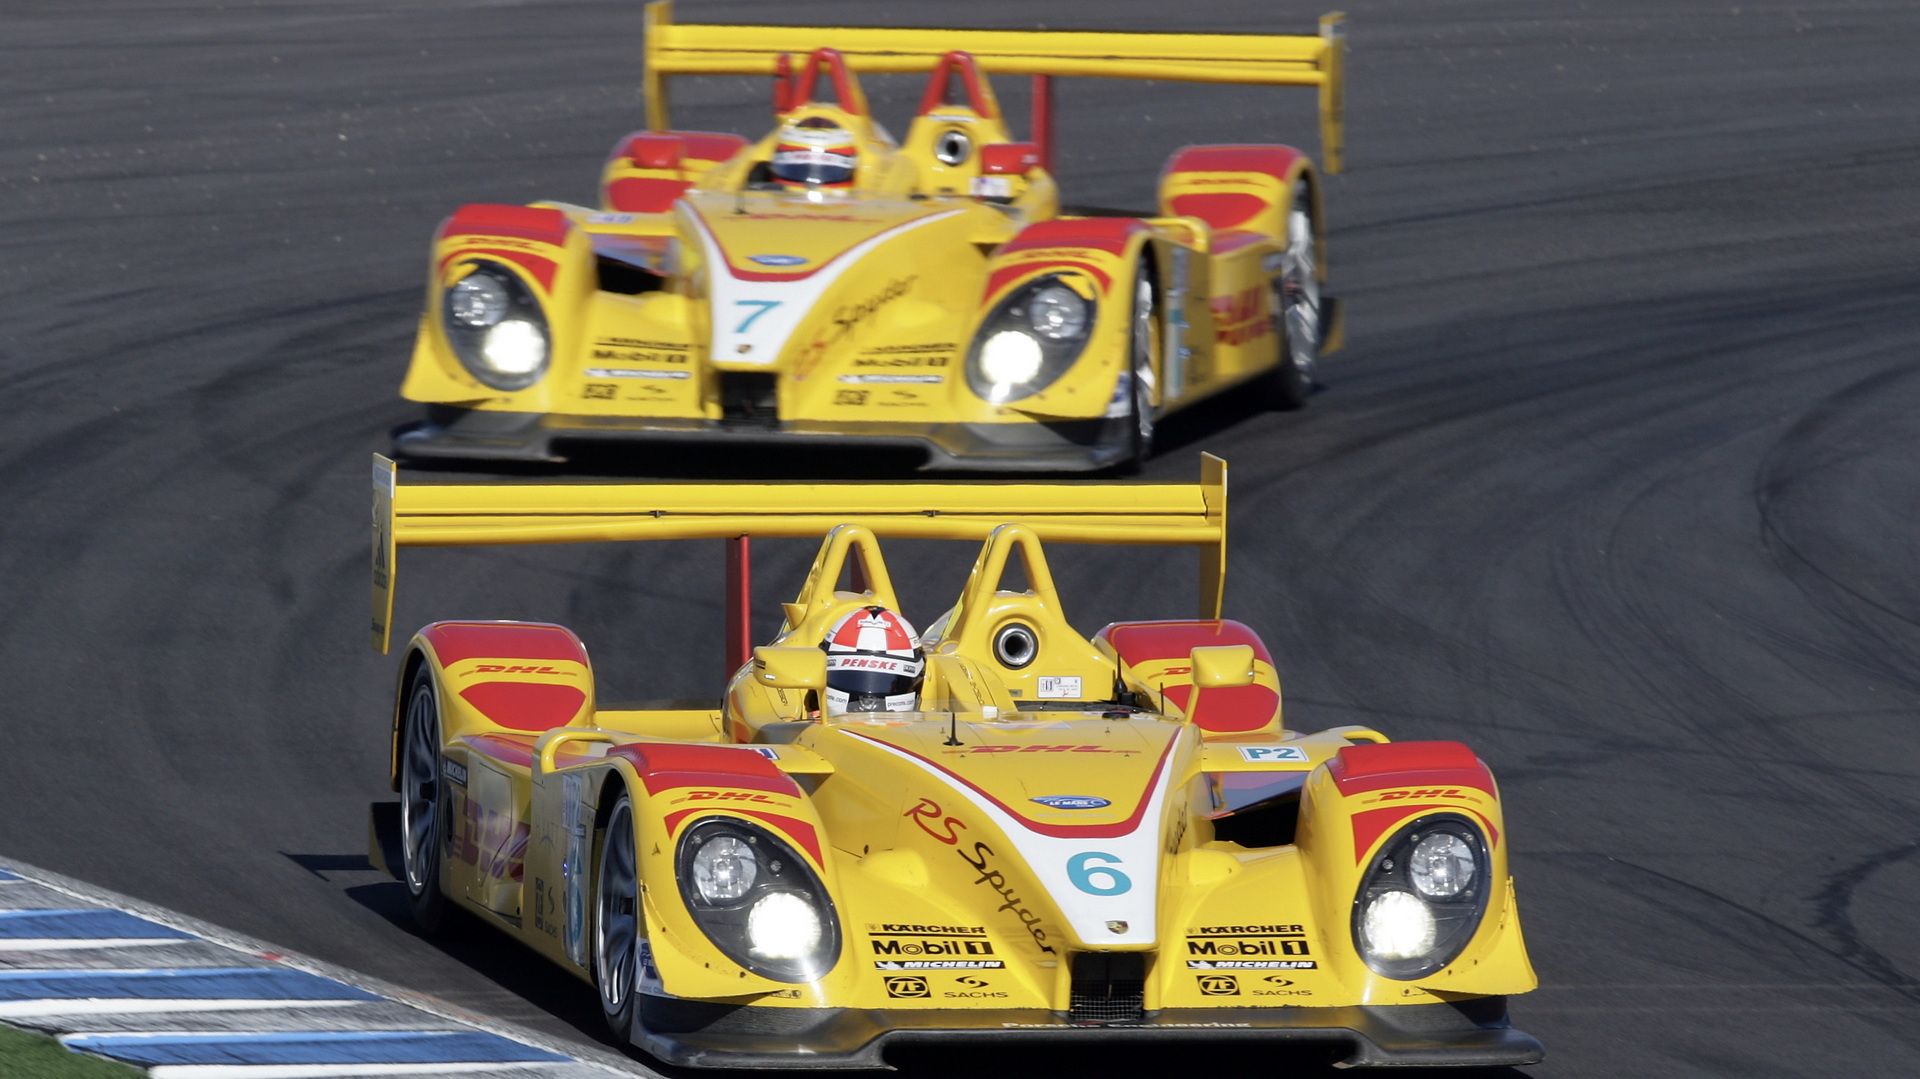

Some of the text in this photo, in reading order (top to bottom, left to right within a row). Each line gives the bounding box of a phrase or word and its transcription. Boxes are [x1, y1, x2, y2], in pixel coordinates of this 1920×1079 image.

[735, 300, 782, 333] 7
[475, 664, 560, 675] DHL
[841, 658, 897, 670] PENSKE
[970, 745, 1111, 753] DHL
[1246, 748, 1299, 759] P2
[687, 791, 775, 804] DHL
[1379, 789, 1467, 801] DHL
[903, 797, 1056, 955] RS Spyder
[1066, 852, 1132, 896] 6
[872, 940, 992, 955] Mobil 1
[1187, 940, 1307, 955] Mobil 1
[904, 961, 1001, 969] MICHELIN
[1215, 961, 1313, 969] MICHELIN
